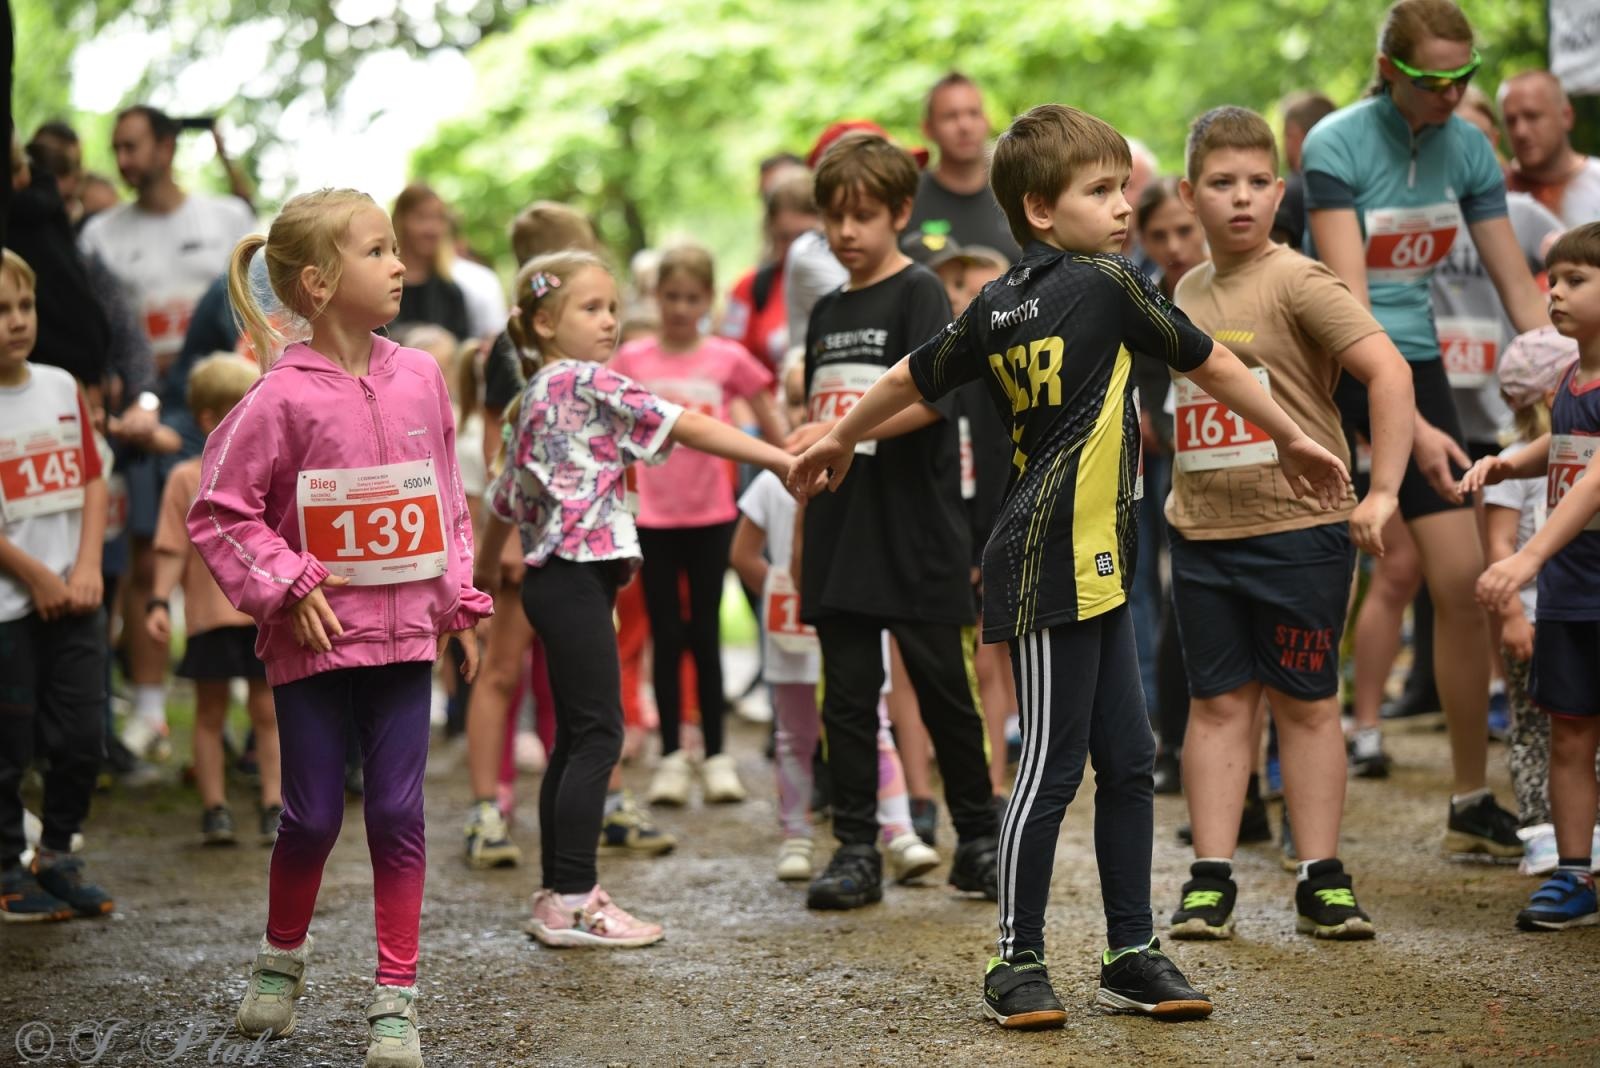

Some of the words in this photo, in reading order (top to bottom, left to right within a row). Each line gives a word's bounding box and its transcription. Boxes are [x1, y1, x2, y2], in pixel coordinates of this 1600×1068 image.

[1391, 233, 1434, 267] 60
[825, 327, 888, 350] SERVICE
[1185, 406, 1253, 447] 161
[18, 451, 80, 496] 145
[310, 478, 337, 492] Bieg
[403, 477, 423, 490] 4500
[423, 476, 432, 487] M
[1549, 466, 1585, 505] 16
[331, 503, 425, 557] 139
[1275, 624, 1331, 652] STYLE
[1280, 648, 1325, 673] NEW
